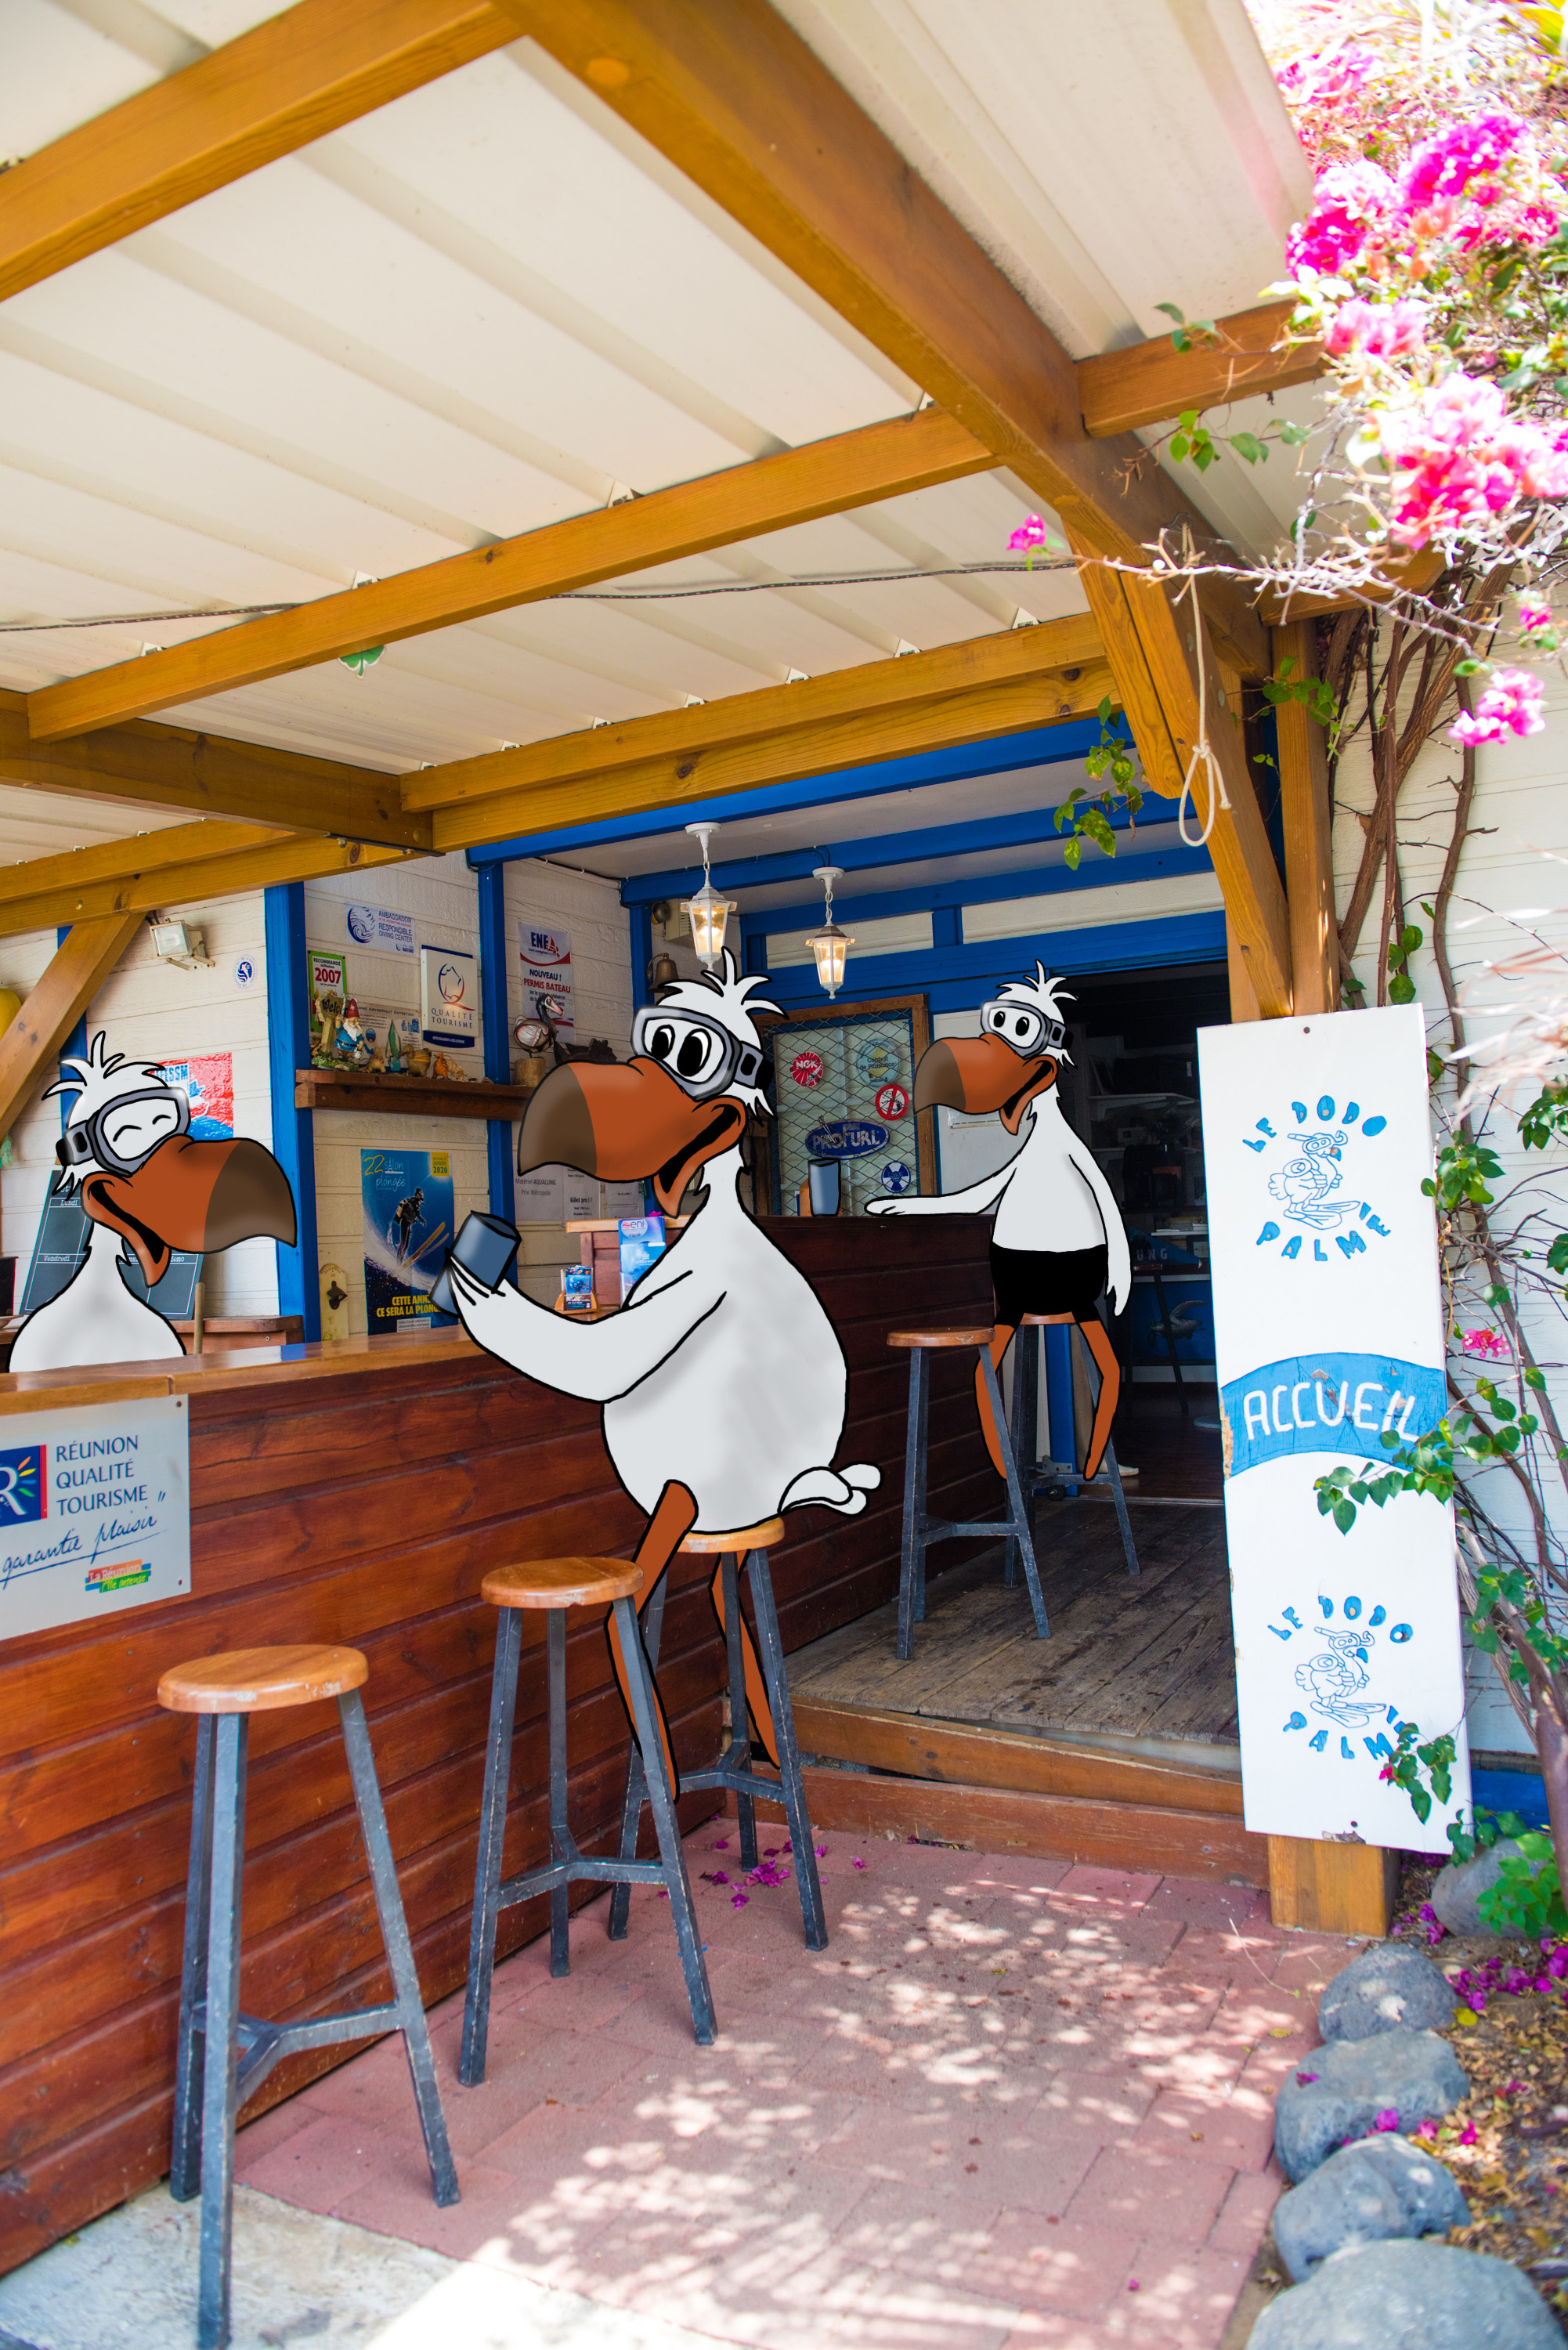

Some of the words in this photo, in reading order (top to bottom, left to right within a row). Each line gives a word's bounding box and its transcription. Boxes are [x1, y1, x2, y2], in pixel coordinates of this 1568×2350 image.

[378, 910, 412, 924] AMBASSADOR
[378, 922, 413, 936] RESPONSIBLE
[378, 930, 395, 939] DIVING
[394, 934, 413, 943] CENTER
[313, 957, 341, 967] RECOMMANDÉ
[315, 967, 341, 984] 2007
[529, 968, 558, 981] NOUVEAU
[523, 978, 545, 989] PERMIS
[546, 982, 571, 993] BATEAU
[431, 1007, 473, 1021] QUALITÉ
[431, 1016, 473, 1029] TOURISME
[796, 1059, 818, 1070] NGK
[1242, 1117, 1277, 1153] LE
[1291, 1095, 1387, 1137] DODO
[811, 1123, 881, 1151] PROFURL
[376, 1175, 406, 1191] plongée
[630, 1220, 645, 1229] enf
[392, 1296, 411, 1306] CETTE
[376, 1307, 385, 1318] CE
[385, 1305, 405, 1317] SERA
[405, 1305, 414, 1315] LA
[415, 1303, 441, 1314] PLONG
[1243, 1381, 1420, 1442] ACCUEIL
[56, 1434, 139, 1463] RÉUNION
[56, 1458, 135, 1489] QUALITÉ
[56, 1484, 148, 1517] TOURISME
[2, 1528, 83, 1590] garantie
[89, 1571, 102, 1582] La
[102, 1563, 142, 1580] Réunion
[1267, 1606, 1303, 1641] LE
[1317, 1595, 1414, 1643] DODO
